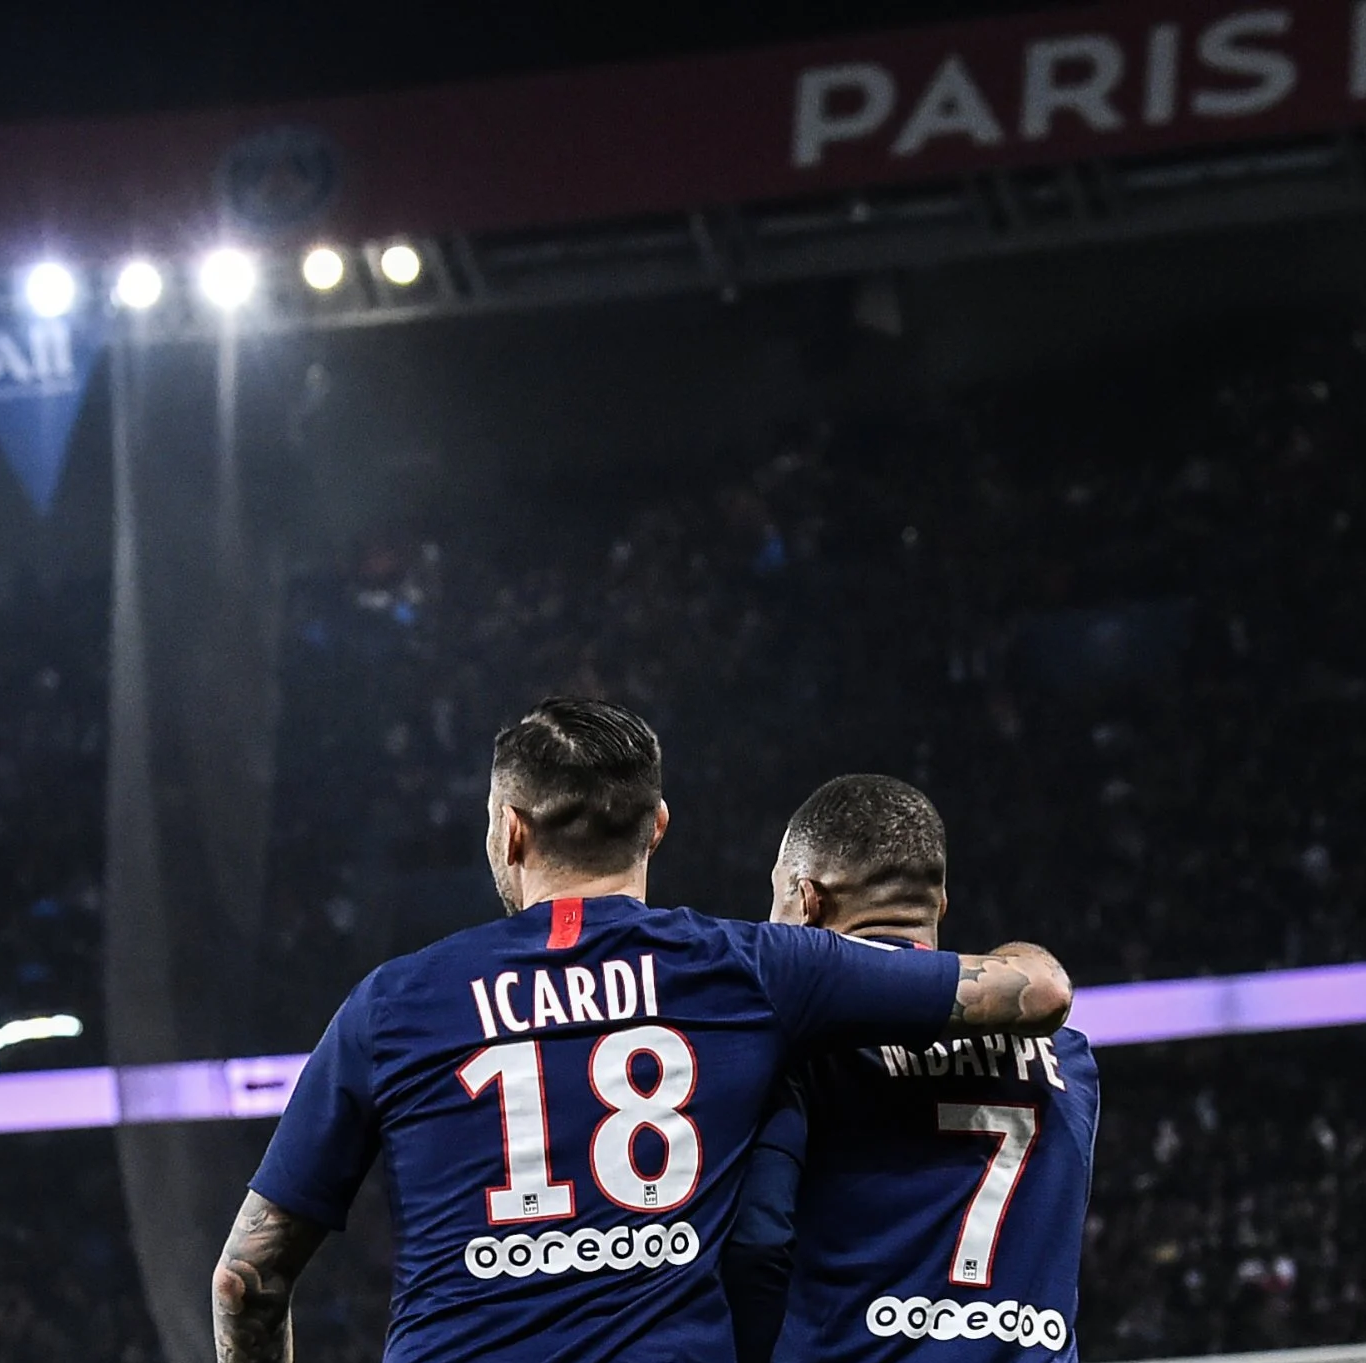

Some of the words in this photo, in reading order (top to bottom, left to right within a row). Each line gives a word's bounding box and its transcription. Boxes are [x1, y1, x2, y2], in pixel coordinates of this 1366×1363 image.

[791, 9, 1298, 169] PARIS
[471, 954, 659, 1039] ICARDI
[455, 1024, 703, 1225] 18
[469, 1223, 695, 1274] ooredoo
[936, 1102, 1040, 1288] 7
[870, 1299, 1063, 1345] ooredoo
